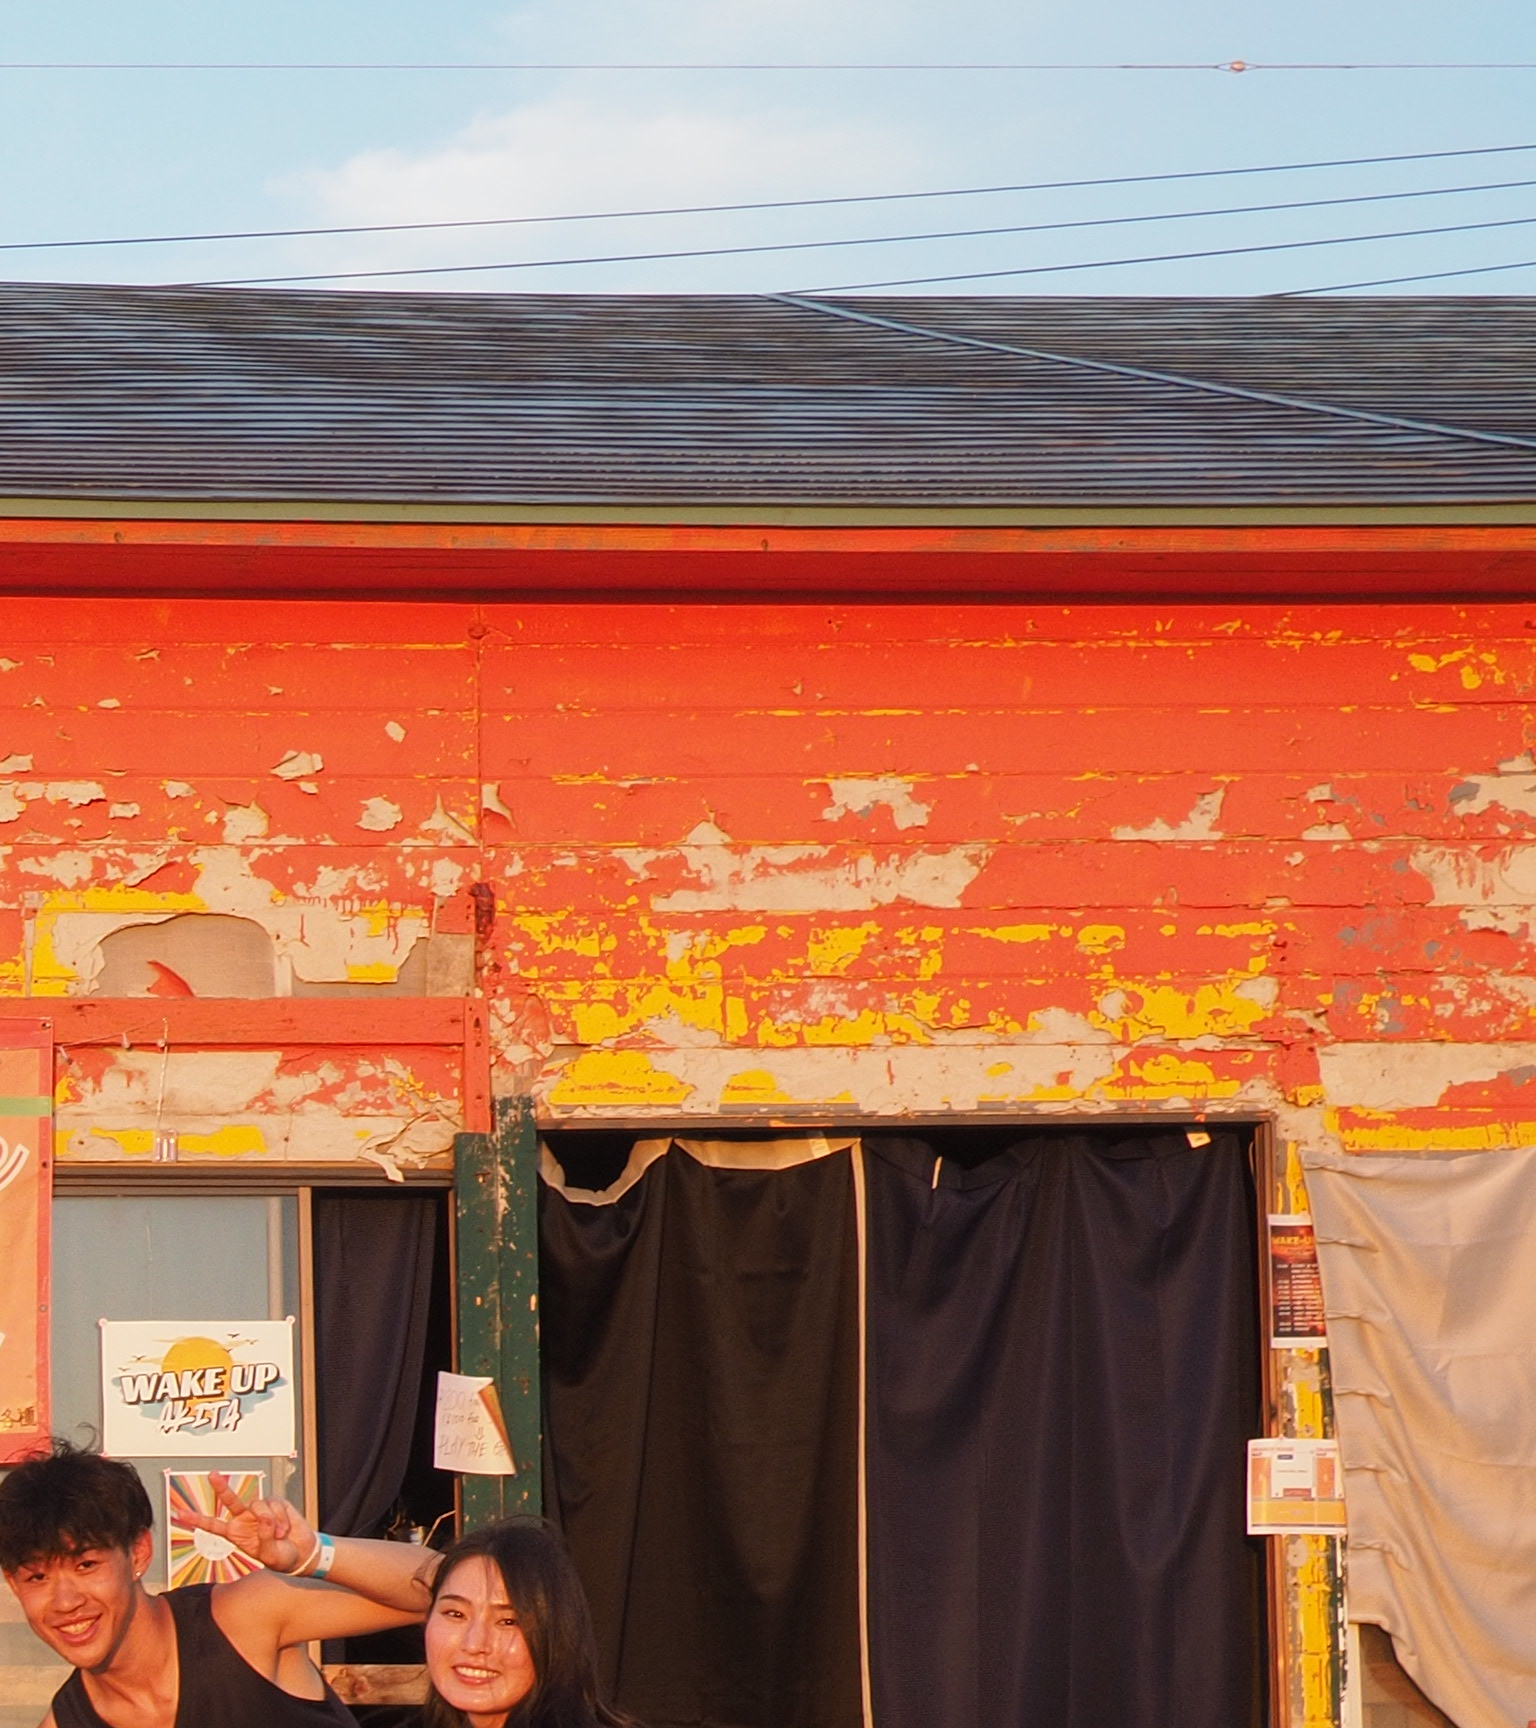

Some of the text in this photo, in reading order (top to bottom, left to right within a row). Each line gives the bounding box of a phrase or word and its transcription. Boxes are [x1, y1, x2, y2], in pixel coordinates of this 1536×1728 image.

[119, 1362, 281, 1405] WAKE UP
[159, 1398, 242, 1434] AKITA
